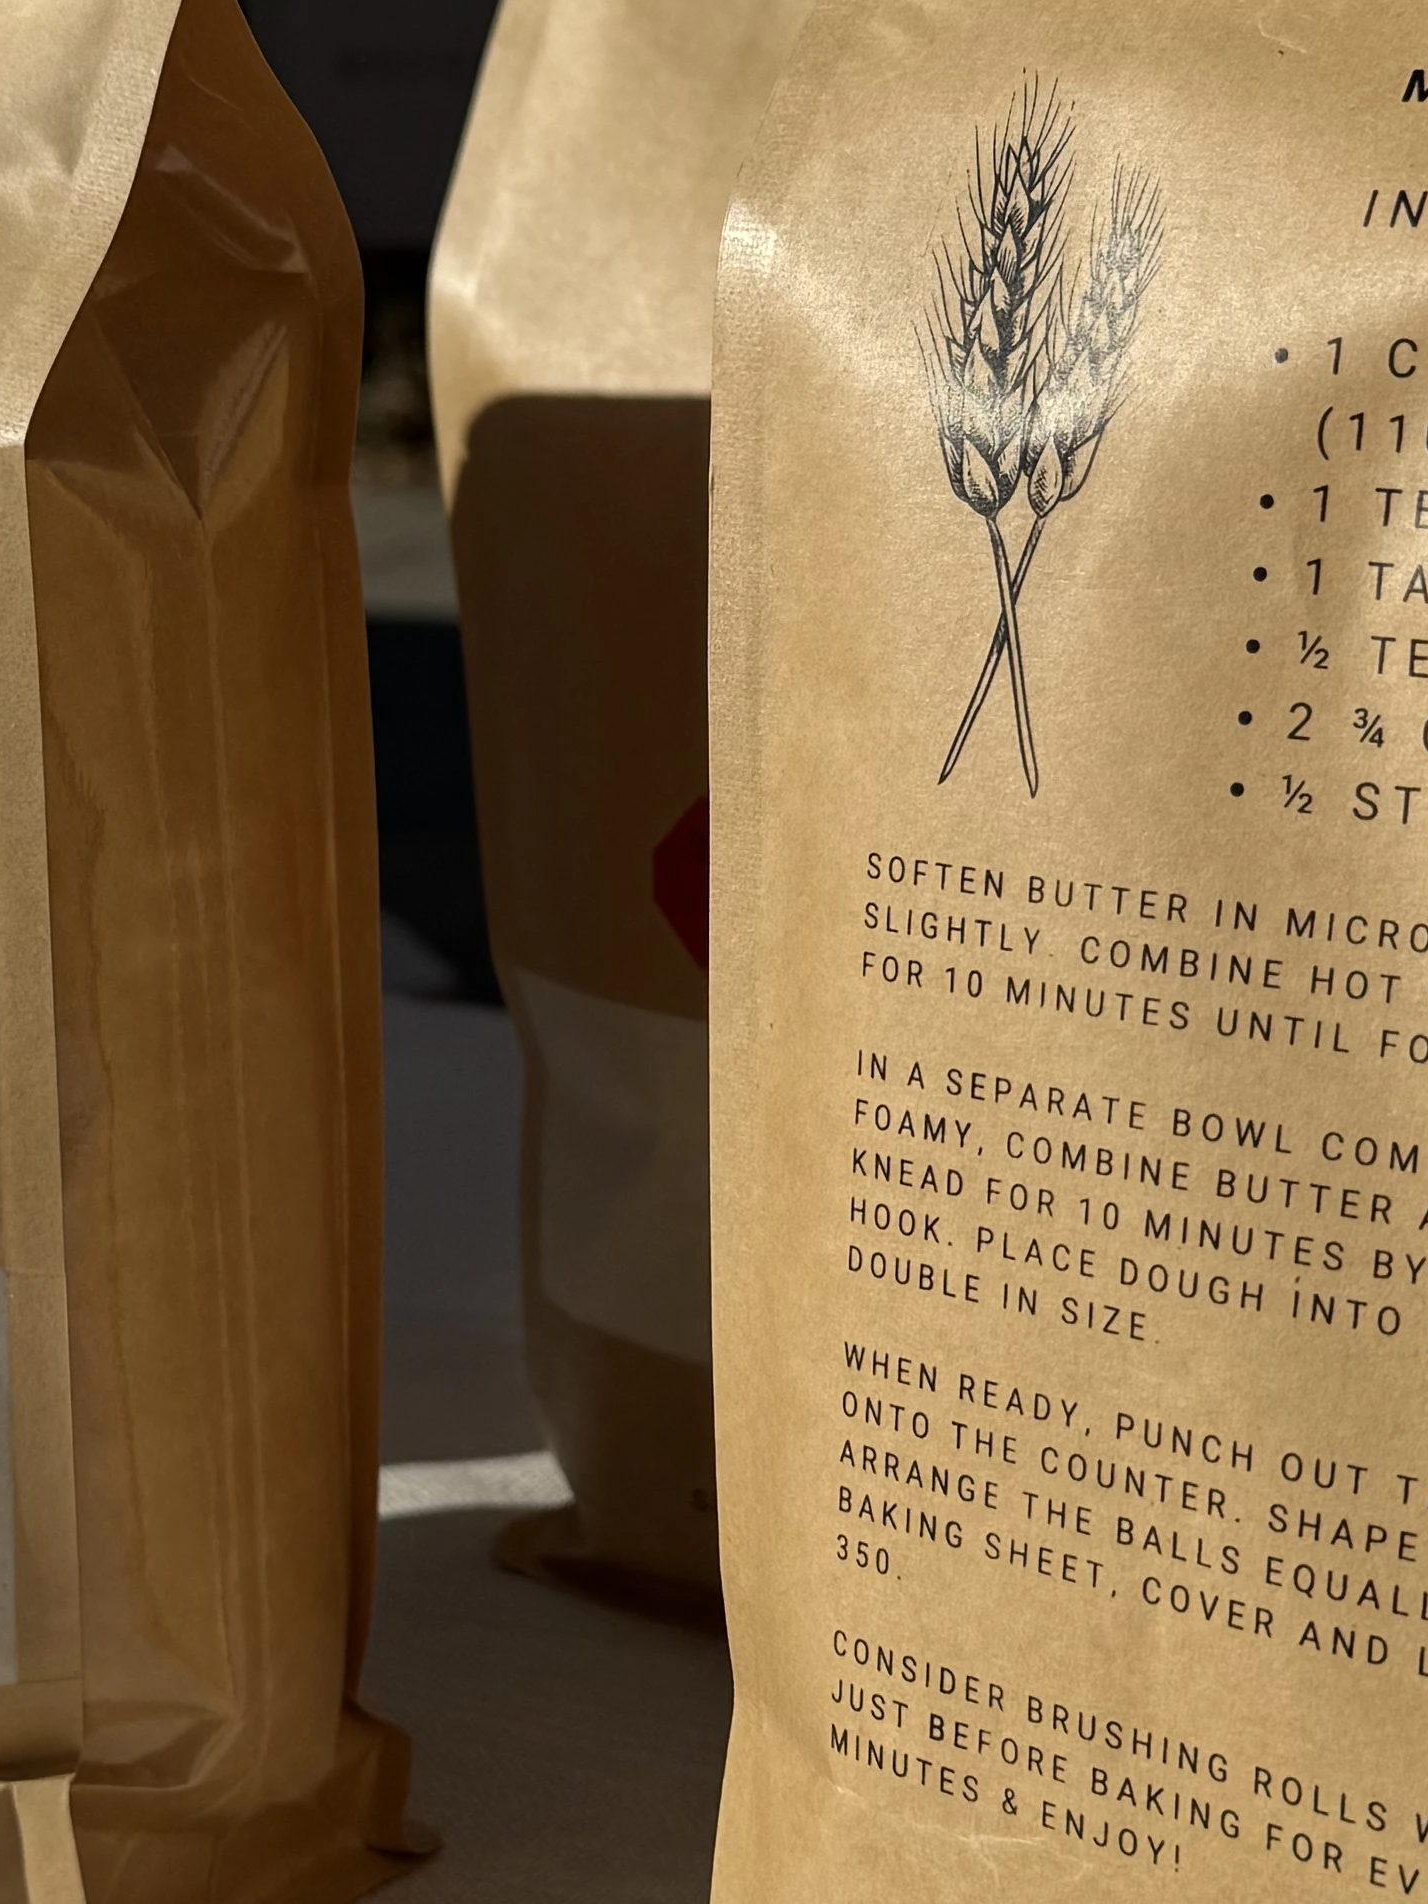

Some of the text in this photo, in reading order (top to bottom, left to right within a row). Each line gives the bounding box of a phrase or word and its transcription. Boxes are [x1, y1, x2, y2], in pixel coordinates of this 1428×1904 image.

[1327, 337, 1343, 375] 1
[1312, 484, 1330, 523] 1
[1306, 557, 1323, 596] 1
[1287, 701, 1314, 742] 2
[866, 851, 1004, 899] SOFTEN
[1027, 875, 1188, 924] BUTTER
[1215, 899, 1258, 932] IN
[862, 950, 924, 988] FOR
[945, 967, 983, 999] 10
[1006, 975, 1190, 1031] MINUTES
[1216, 1006, 1350, 1054] UNTIL
[857, 1049, 888, 1082] IN
[906, 1061, 925, 1090] A
[946, 1068, 1147, 1131] SEPARATE
[1172, 1107, 1292, 1155] BOWL
[844, 1341, 938, 1393] WHEN
[1115, 1412, 1253, 1472] PUNCH
[1280, 1452, 1369, 1495] OUT
[833, 1629, 1005, 1712] CONSIDER
[1027, 1695, 1228, 1783] BRUSHING
[1253, 1766, 1388, 1833] ROLLS
[831, 1723, 1181, 1873] MINUTES & ENJOY!
